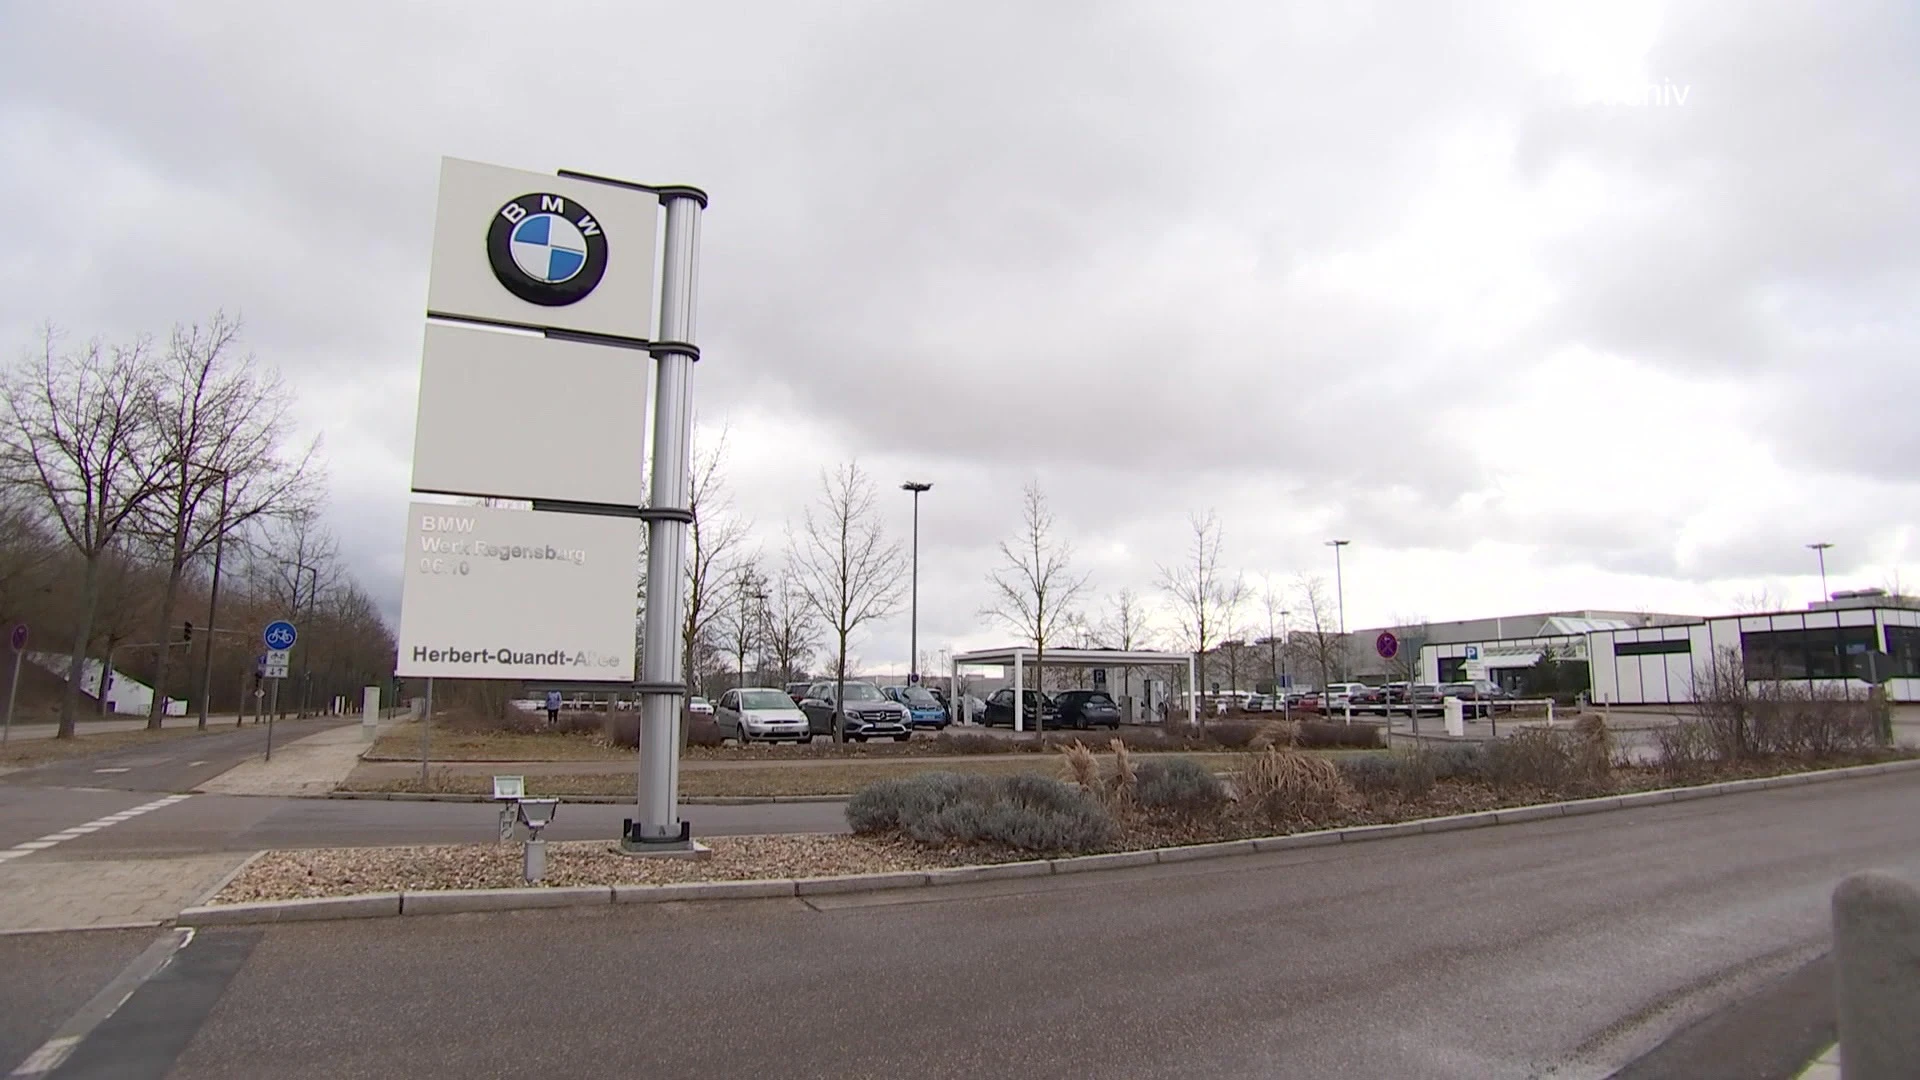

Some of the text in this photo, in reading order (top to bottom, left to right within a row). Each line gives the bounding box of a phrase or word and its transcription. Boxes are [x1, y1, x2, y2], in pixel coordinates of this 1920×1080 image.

[501, 195, 601, 237] BMW
[421, 516, 475, 533] BMW
[421, 536, 586, 564] Werk Regensburg
